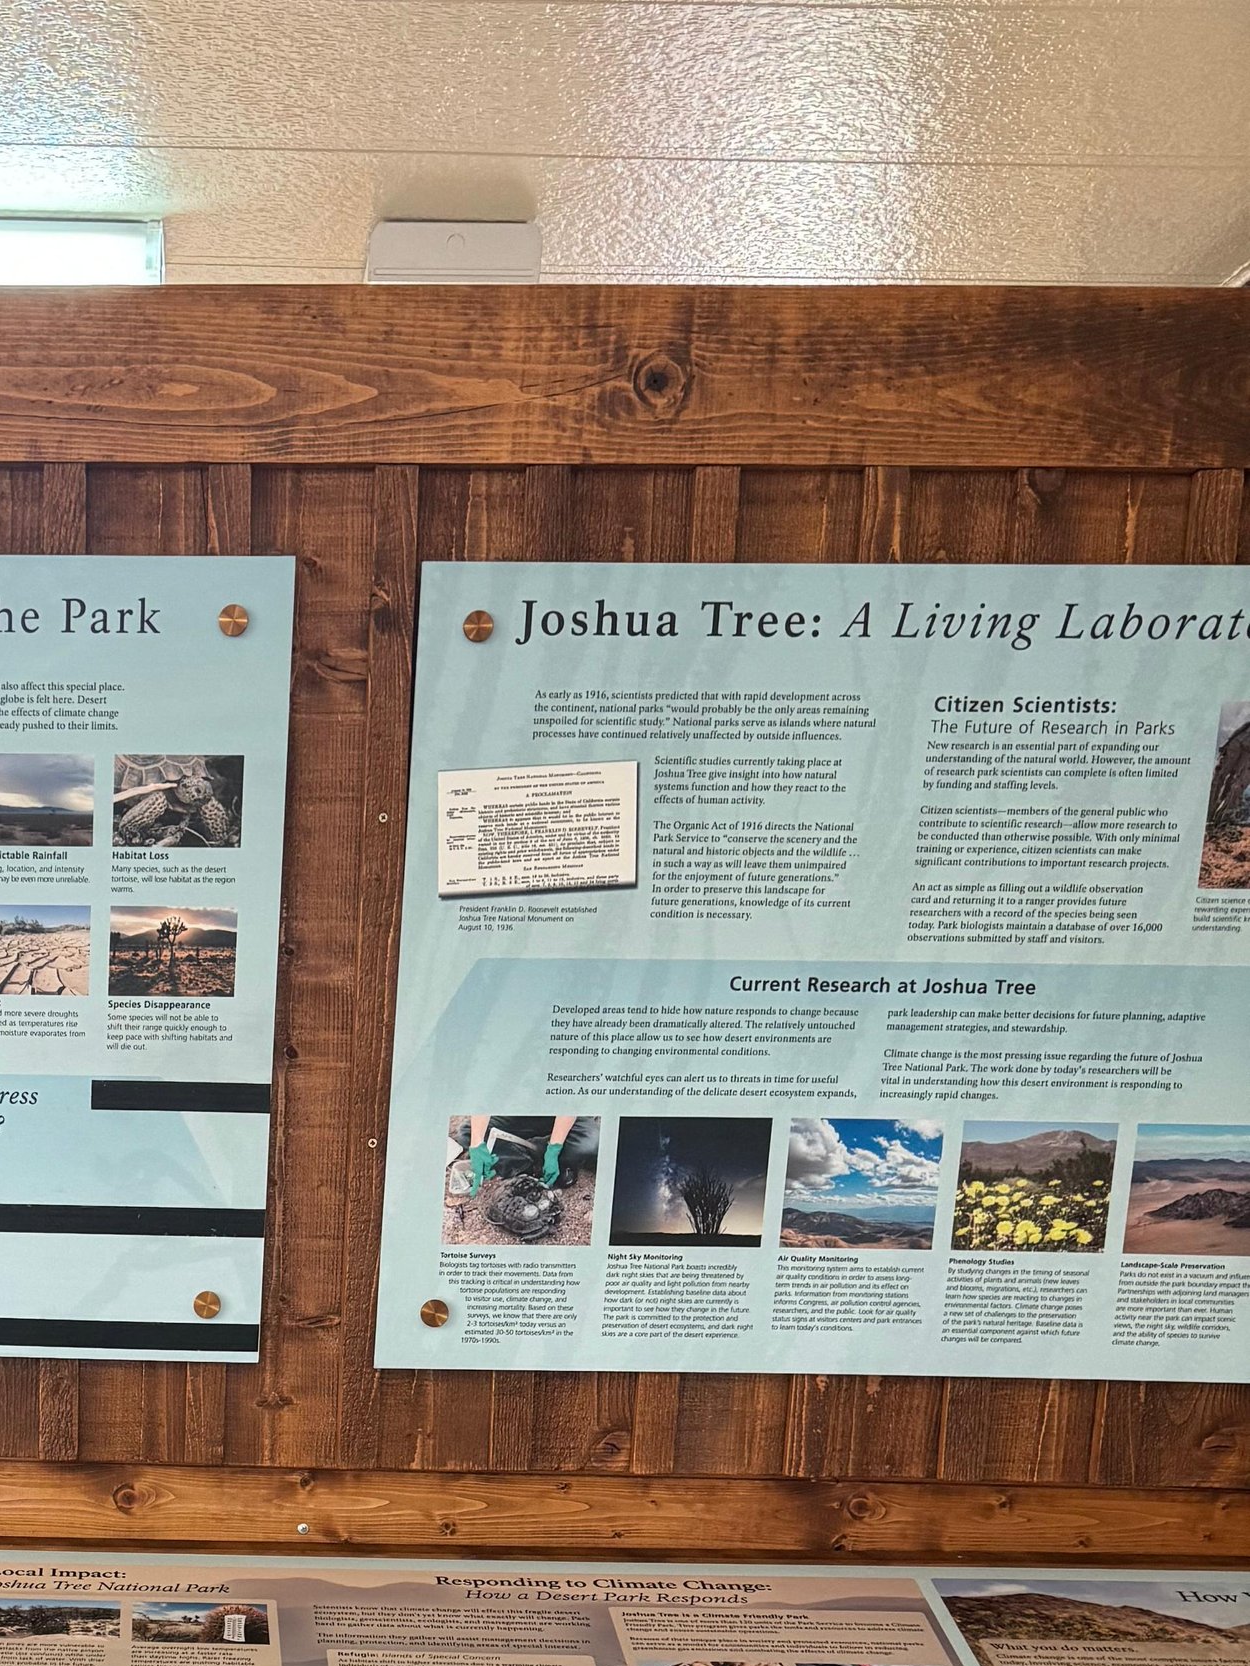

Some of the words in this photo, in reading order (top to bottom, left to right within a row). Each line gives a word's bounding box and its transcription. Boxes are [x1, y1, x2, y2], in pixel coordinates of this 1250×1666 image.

[60, 597, 161, 634] Park
[515, 599, 679, 645] Joshua
[700, 600, 821, 638] Tree:
[839, 601, 871, 638] A
[890, 602, 1040, 651] Living
[1054, 602, 1250, 640] Laborat
[934, 695, 1004, 713] Citizen
[1012, 695, 1116, 713] Scientists:
[930, 718, 958, 734] The
[964, 719, 1013, 734] Future
[1018, 718, 1036, 734] of
[1041, 719, 1108, 735] Research
[1114, 720, 1128, 735] in
[1135, 720, 1175, 735] Parks
[32, 850, 67, 860] Rainfall
[112, 850, 147, 860] Habitat
[149, 851, 169, 860] Loss
[729, 975, 801, 992] Current
[807, 976, 890, 993] Research
[897, 979, 917, 993] at
[922, 977, 987, 995] Joshua
[994, 979, 1036, 995] Tree
[108, 999, 141, 1010] Species
[144, 999, 211, 1011] Disappearance
[440, 1251, 468, 1259] Tortoise
[469, 1251, 496, 1260] Surveys
[607, 1253, 627, 1261] Night
[628, 1253, 642, 1262] Sky
[643, 1253, 683, 1262] Monitoring
[790, 1255, 817, 1263] Quality
[818, 1255, 858, 1264] Monitoring
[948, 1257, 987, 1266] Phenology
[1120, 1261, 1179, 1269] Landscape-Scale
[1180, 1262, 1225, 1270] Preservation
[50, 1565, 127, 1577] Impact:
[53, 1578, 92, 1588] Tree
[96, 1581, 180, 1592] National
[184, 1583, 230, 1593] Park
[435, 1575, 561, 1590] Responding
[565, 1579, 587, 1588] to
[592, 1578, 677, 1589] Climate
[682, 1579, 772, 1593] Change:
[465, 1587, 511, 1597] How
[517, 1592, 529, 1600] a
[536, 1588, 597, 1599] Desert
[603, 1589, 650, 1600] Park
[657, 1590, 748, 1604] Responds
[1175, 1591, 1237, 1603] How
[989, 1642, 1029, 1651] What
[1031, 1645, 1058, 1653] you
